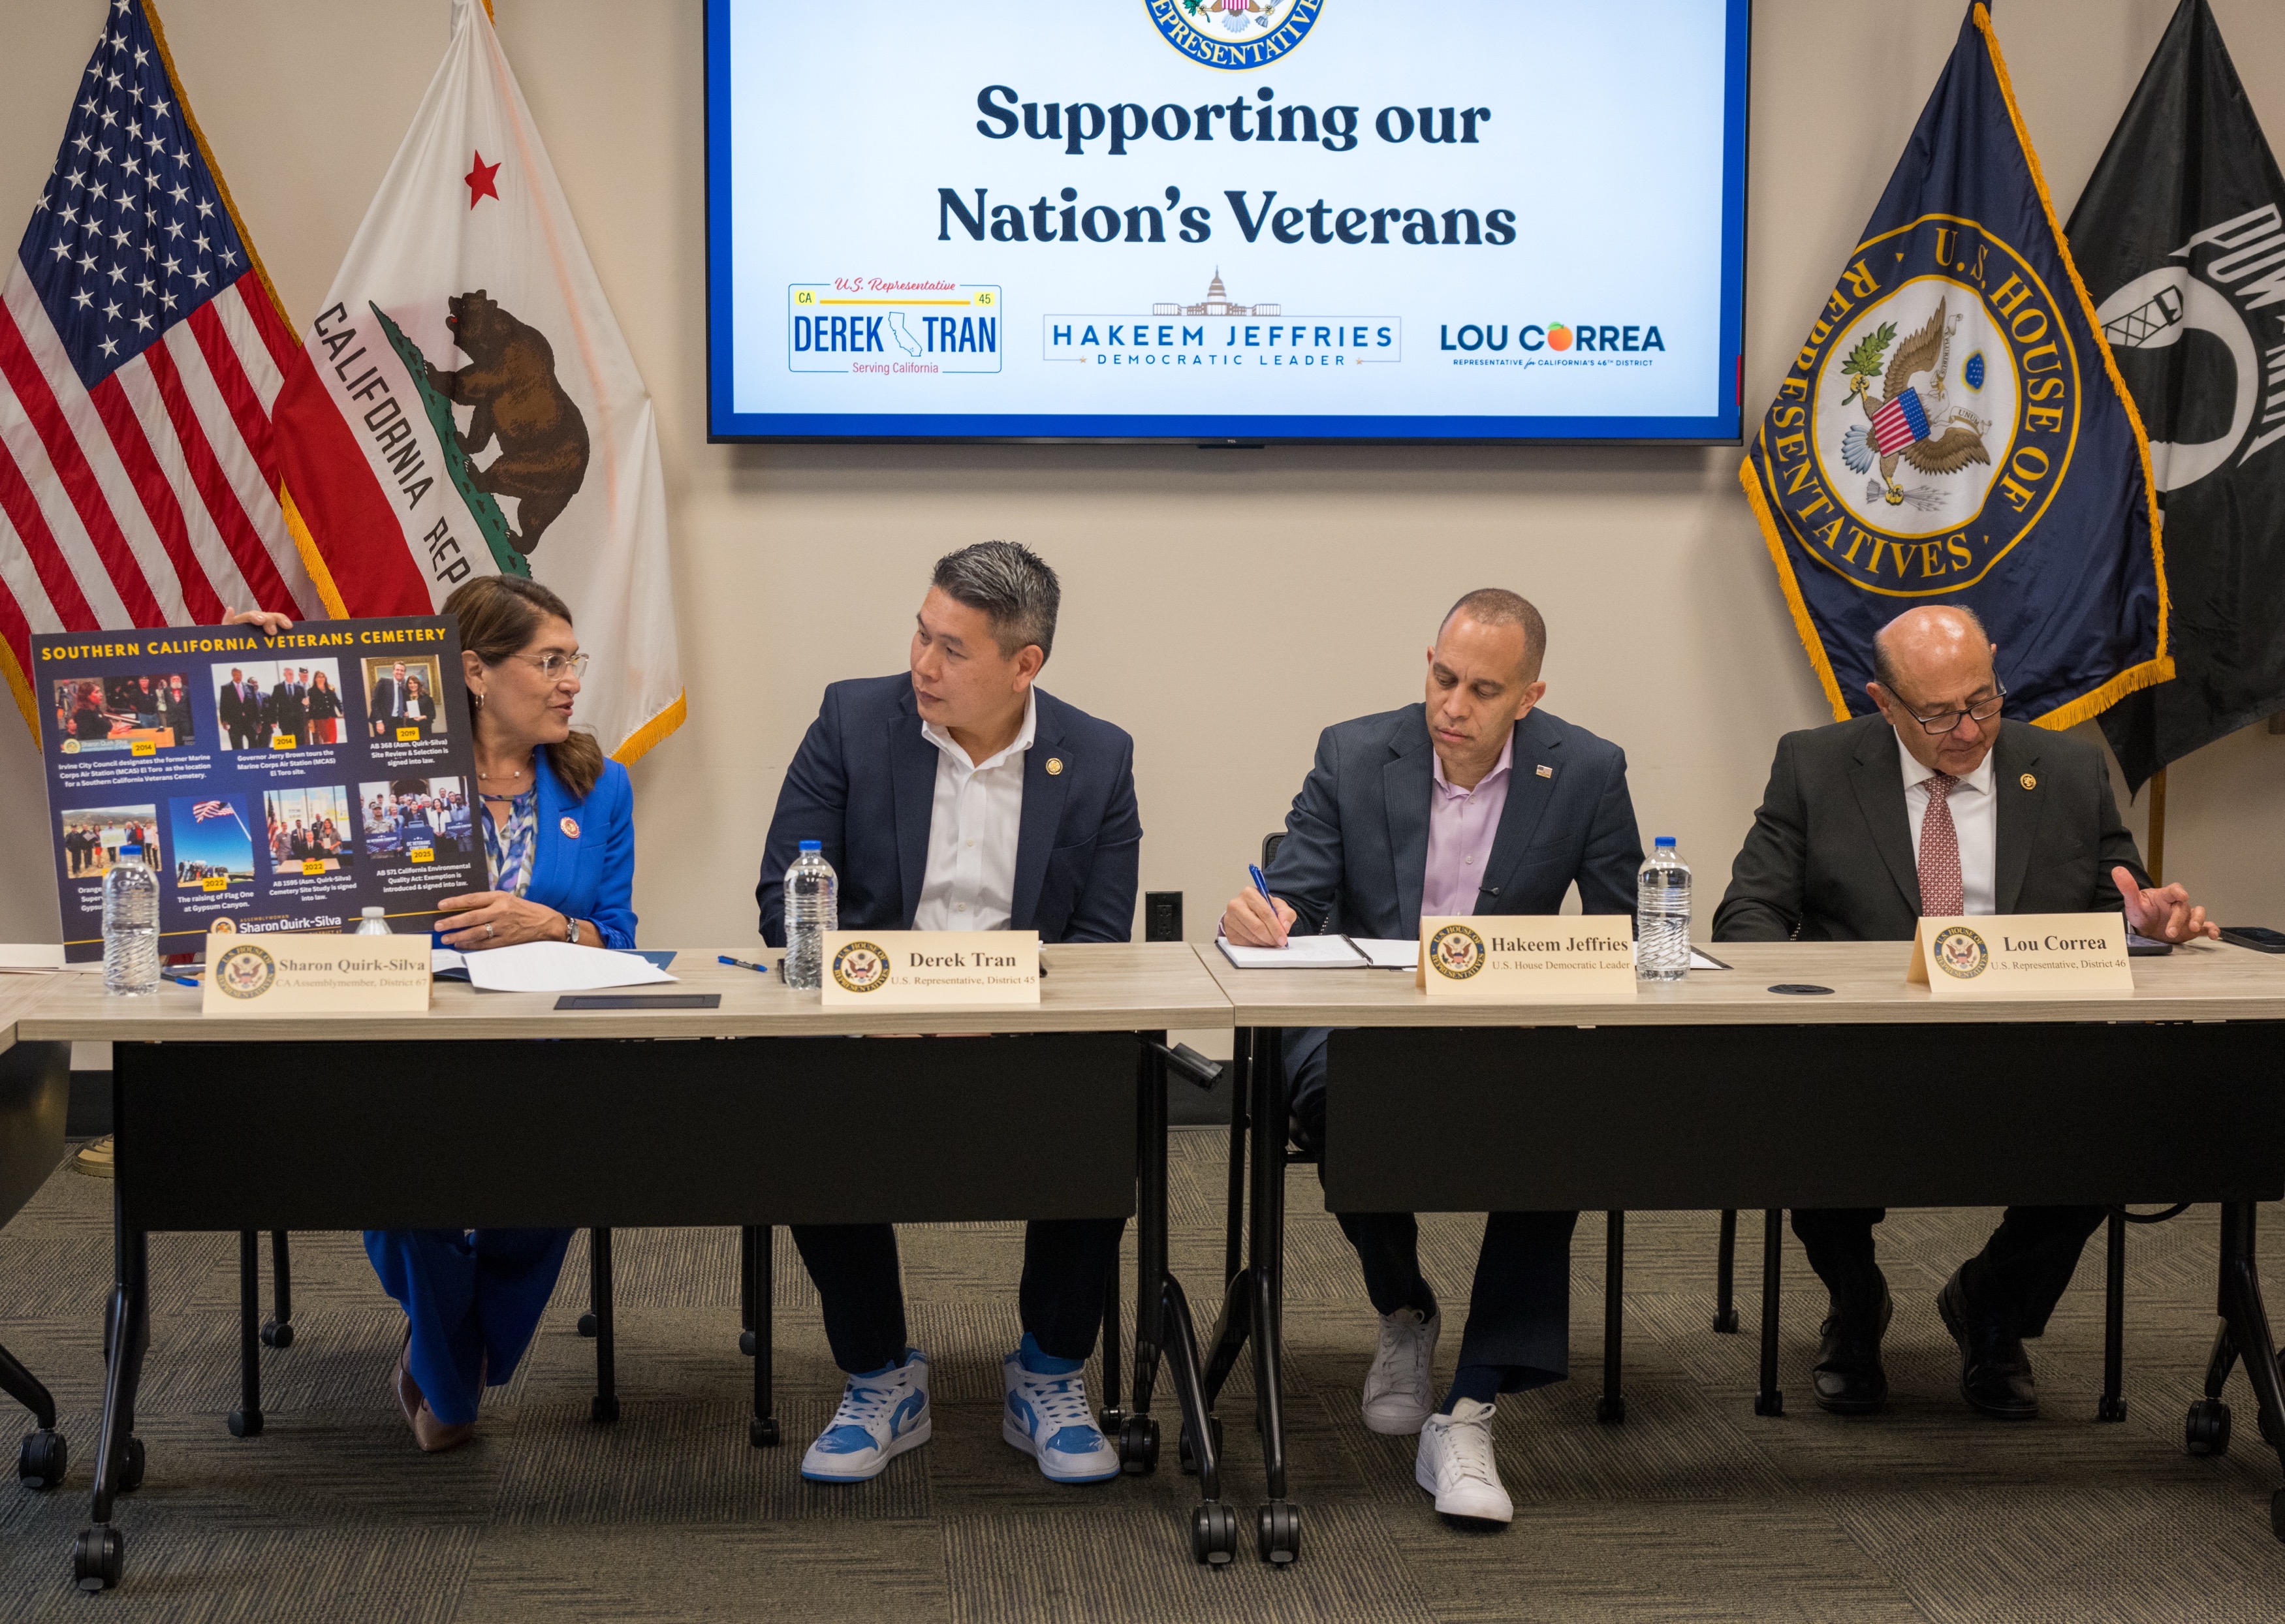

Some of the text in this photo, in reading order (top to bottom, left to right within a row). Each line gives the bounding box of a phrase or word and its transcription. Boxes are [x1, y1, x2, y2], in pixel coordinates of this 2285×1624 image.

[976, 84, 1491, 155] Supporting our
[938, 185, 1517, 246] Nation's Veterans
[834, 277, 956, 293] U.S. Representative
[798, 292, 812, 304] CA
[979, 294, 991, 304] 45
[795, 316, 996, 352] DEREK TRAN
[1053, 325, 1392, 347] HAKEEM JEFFRIES
[1441, 324, 1508, 351] LOU
[1097, 354, 1345, 366] DEMOCRATIC LEADER
[1524, 357, 1536, 370] for
[853, 362, 939, 375] Serving California
[1936, 228, 2064, 512] U.S. HOUSE OF
[313, 301, 434, 511] CALIFORNIA
[1959, 409, 1979, 426] UNUM
[41, 628, 446, 661] SOUTHERN CALIFORNIA VETERANS CEMETERY
[118, 758, 153, 767] designates
[174, 772, 207, 780] Cemetery.
[398, 866, 427, 875] California
[428, 863, 471, 873] Environmental
[317, 875, 351, 884] Quirk-Silva)
[424, 873, 456, 882] Exemption
[338, 882, 356, 891] signed
[383, 884, 417, 893] introduced
[193, 904, 221, 913] Gypsum
[222, 901, 250, 911] Canyon.
[240, 916, 341, 933] Sharon Quirk-Silva
[1492, 937, 1628, 952] Hakeem Jeffries
[2003, 935, 2107, 952] Lou Correa
[279, 959, 332, 971] Sharon
[338, 959, 425, 973] Quirk-Silva
[909, 952, 1016, 967] Derek Tran
[1492, 961, 1630, 970] U.S. House Democratic Leader
[1991, 960, 2126, 971] U.S. Representative, District 46
[294, 979, 377, 990] Assemblymember,
[379, 978, 415, 987] District
[891, 976, 1035, 986] U.S. Representative, District 45
